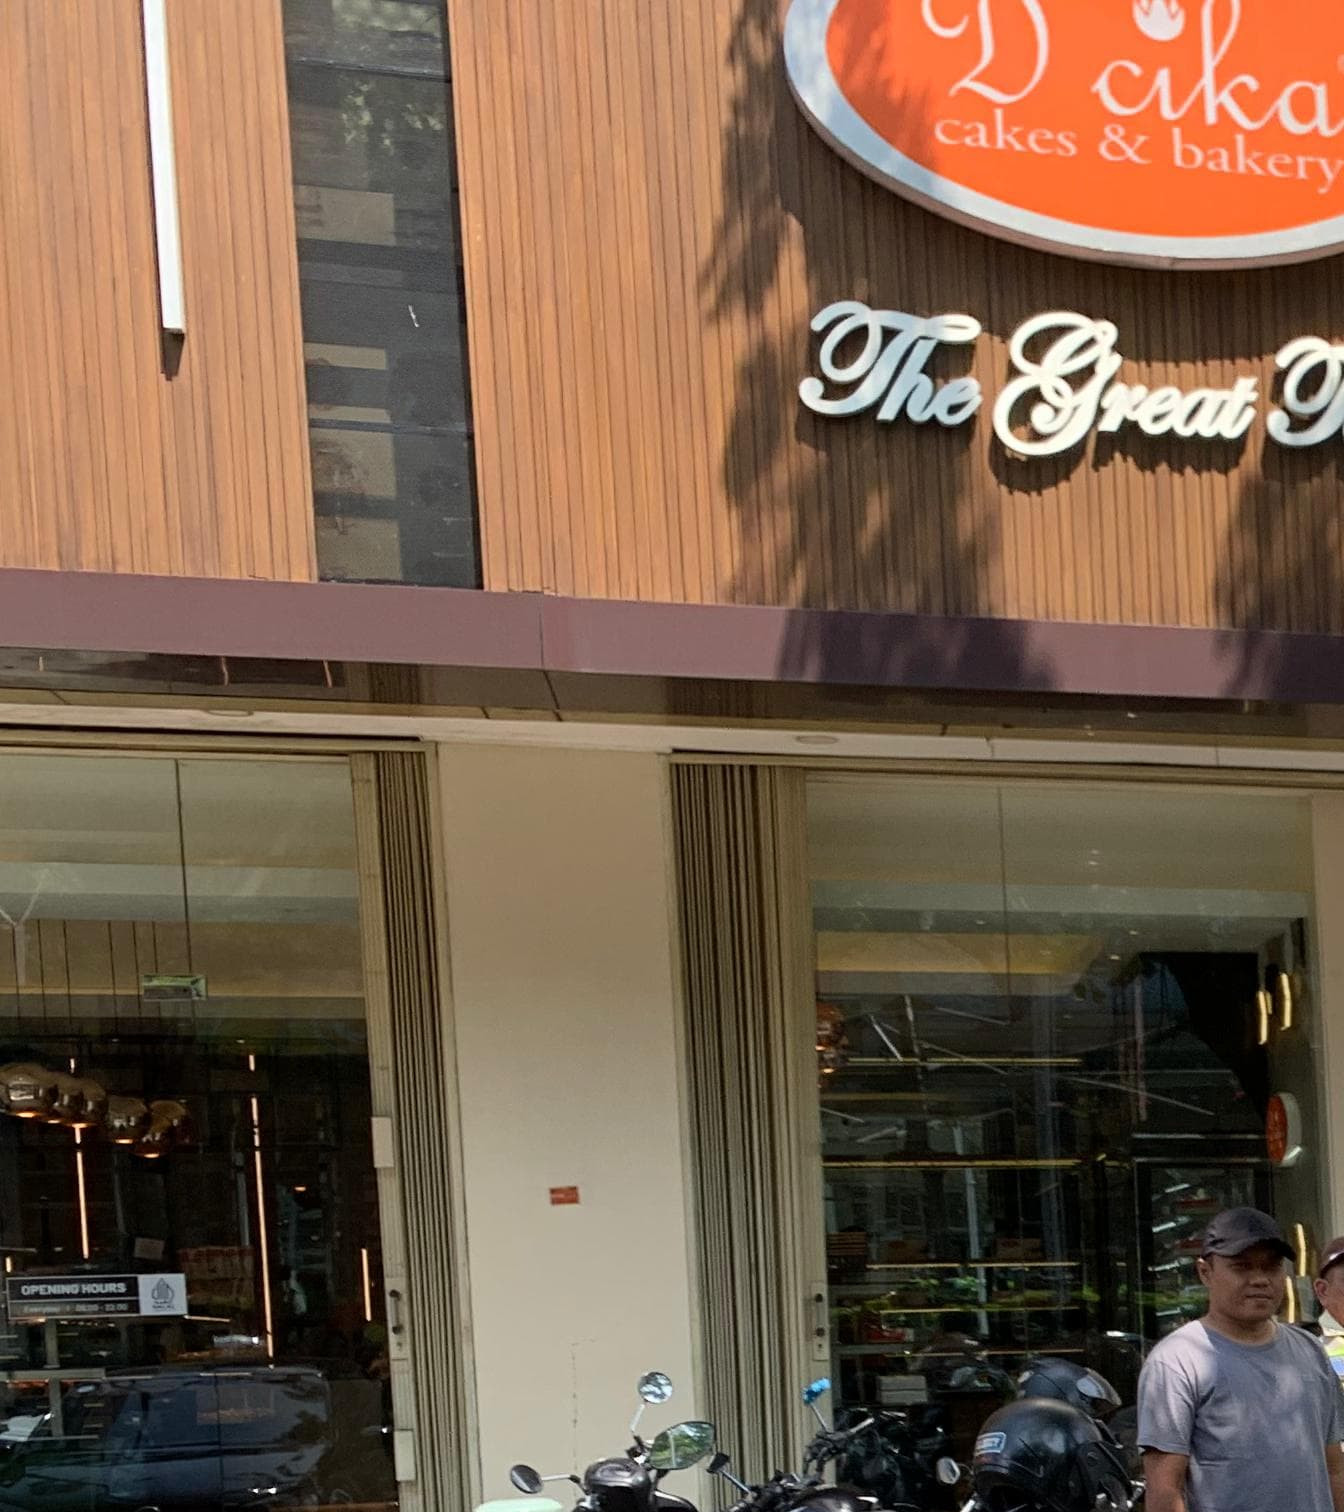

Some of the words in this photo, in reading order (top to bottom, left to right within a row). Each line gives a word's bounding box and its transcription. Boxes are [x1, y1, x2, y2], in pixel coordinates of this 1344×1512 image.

[934, 108, 1078, 157] cakes
[1098, 124, 1151, 164] &
[1172, 127, 1344, 194] bakery
[800, 301, 983, 428] The
[992, 311, 1259, 457] Great
[21, 1284, 78, 1296] OPENING
[82, 1282, 127, 1294] HOURS
